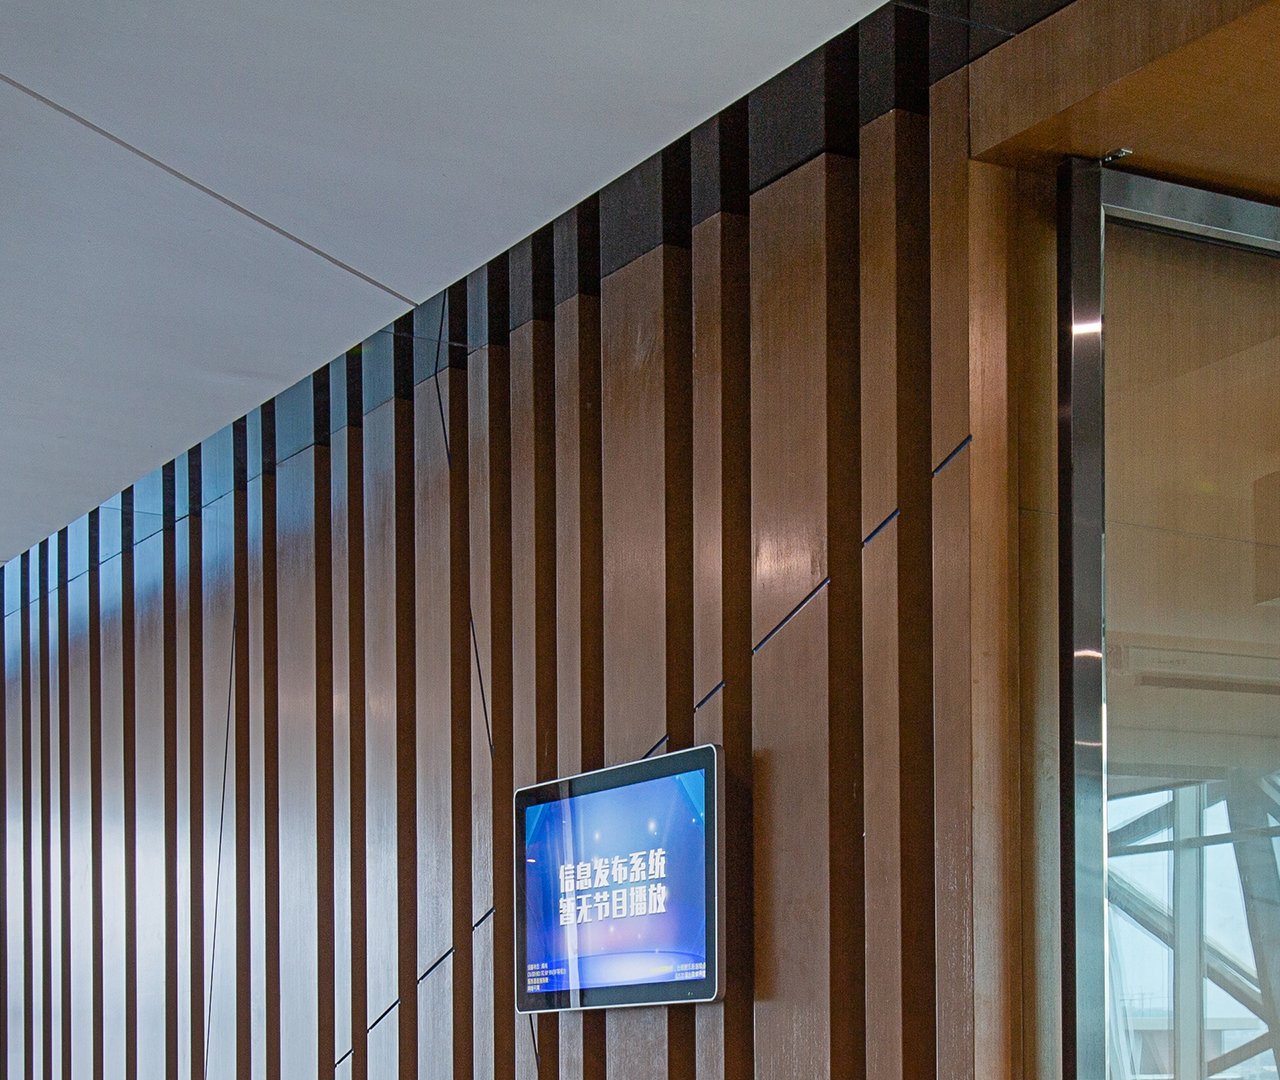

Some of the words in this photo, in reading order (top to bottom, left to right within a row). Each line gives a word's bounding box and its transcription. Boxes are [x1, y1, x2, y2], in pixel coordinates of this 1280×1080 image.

[559, 848, 666, 893] 信息发布系统
[559, 883, 666, 926] 暂无节目播放
